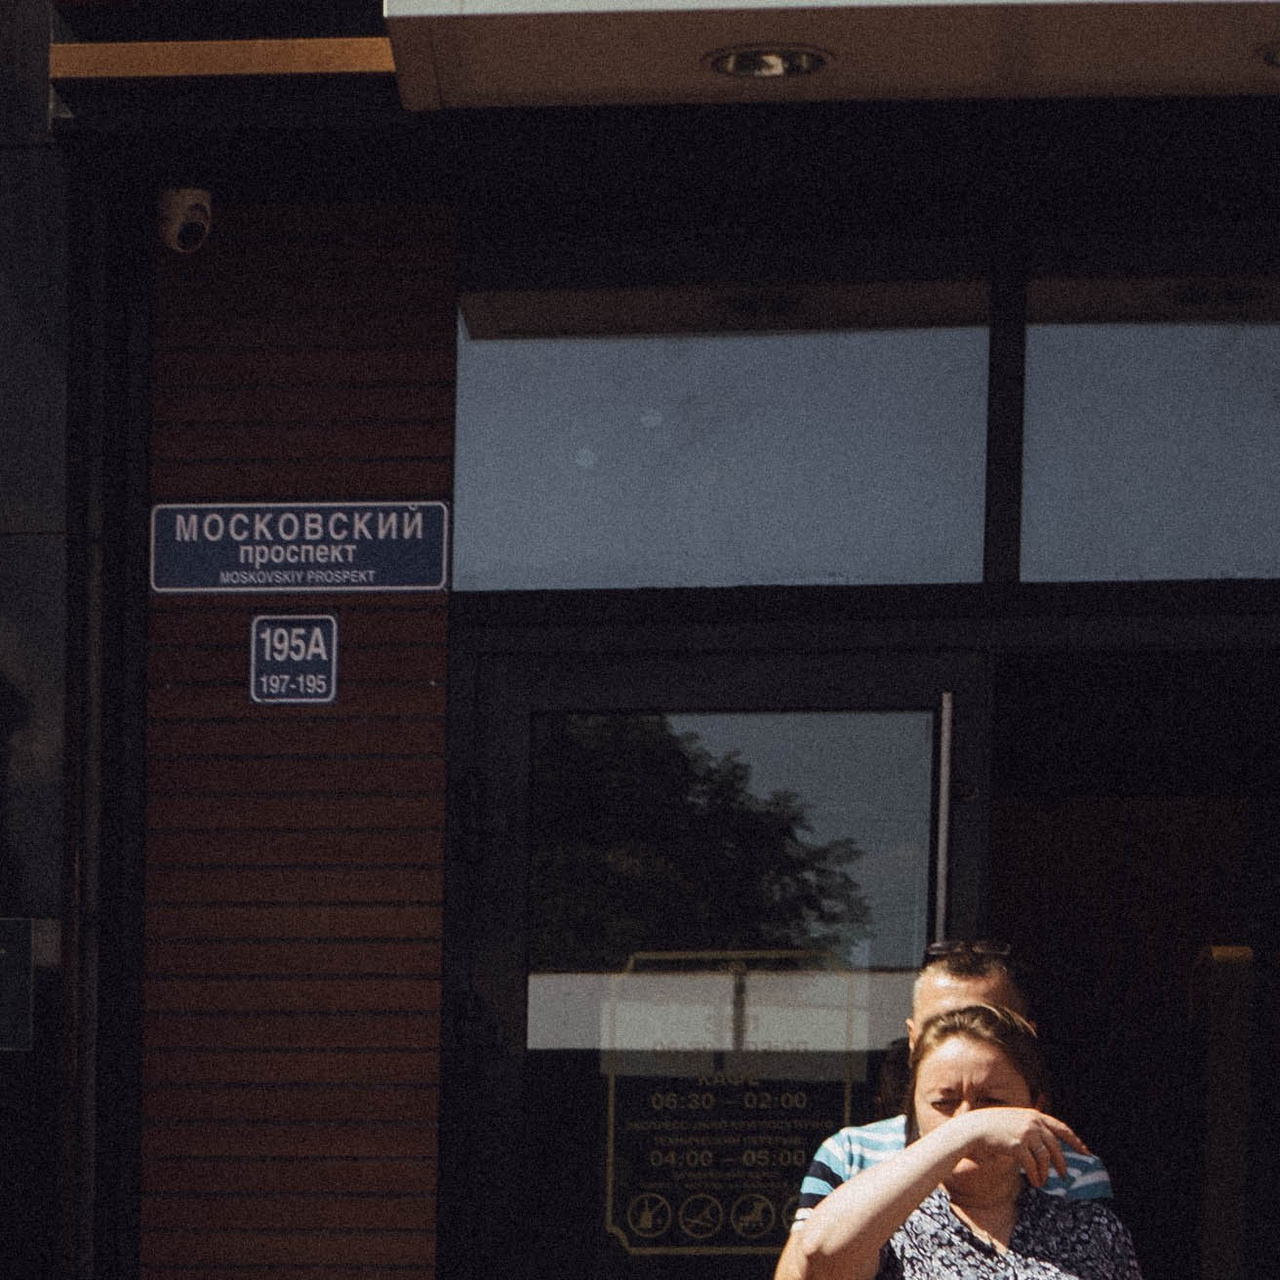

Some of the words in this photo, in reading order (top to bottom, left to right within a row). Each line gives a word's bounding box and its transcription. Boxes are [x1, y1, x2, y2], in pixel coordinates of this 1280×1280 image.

[174, 503, 423, 541] МОСКОВСКИЙ
[238, 543, 357, 570] проспект
[220, 570, 304, 585] MOSKOVSKIY
[306, 569, 376, 584] PROSPEKT
[260, 627, 329, 662] 195А
[260, 674, 327, 694] 197-195
[650, 1091, 716, 1110] 06:30
[743, 1091, 808, 1109] 02:00
[649, 1149, 714, 1167] 04:00
[741, 1149, 807, 1167] 05:00
